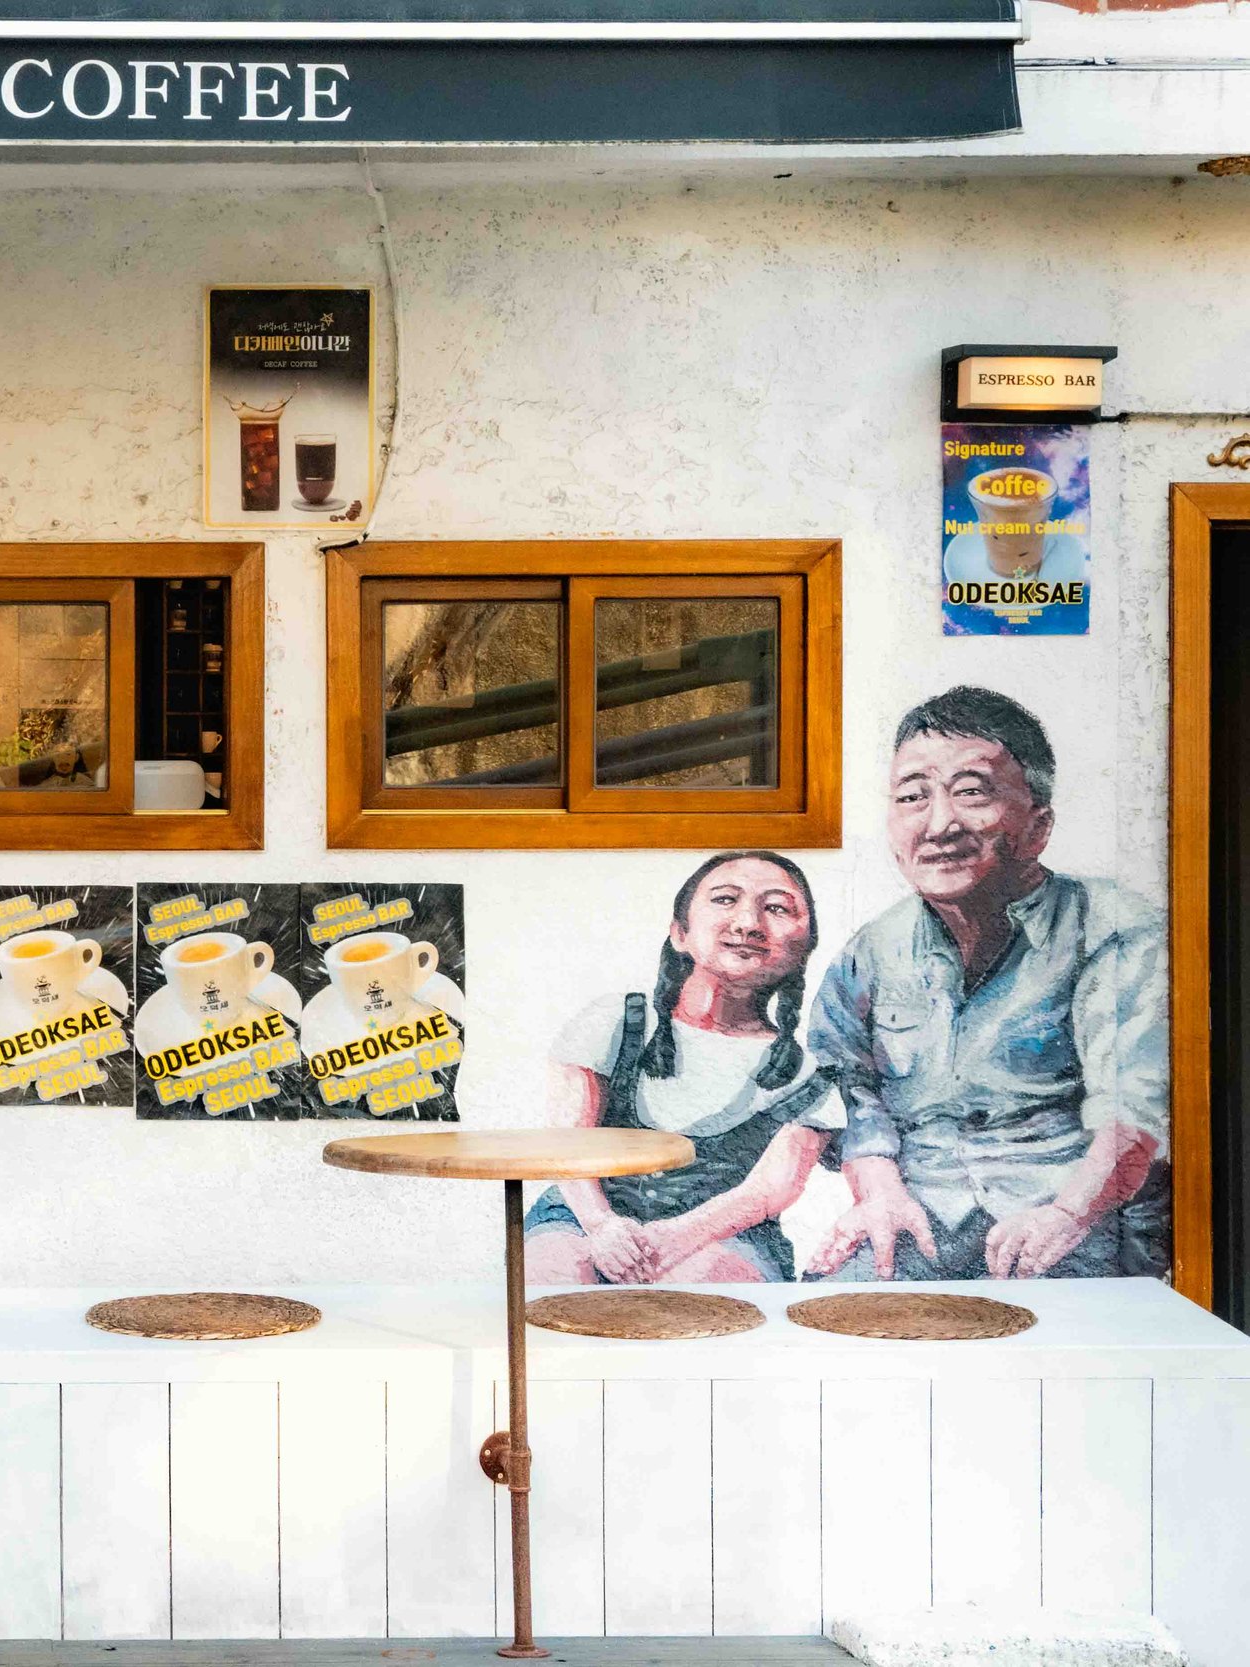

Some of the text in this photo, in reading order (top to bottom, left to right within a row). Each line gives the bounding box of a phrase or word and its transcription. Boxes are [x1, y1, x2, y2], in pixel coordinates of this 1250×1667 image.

[0, 58, 352, 122] COFFEE
[978, 373, 1096, 387] ESPRESSO BAR
[944, 440, 1025, 460] Signature
[975, 475, 1050, 497] Coffee
[944, 519, 1086, 536] Nut cream coffee
[948, 581, 1084, 606] ODEOKSAE
[45, 902, 75, 921] BAR
[147, 902, 245, 941] Espresso BAR
[152, 897, 202, 922] SEOUL
[311, 901, 409, 941] Espresso BAR
[316, 897, 366, 922] SEOUL
[83, 1030, 126, 1060] BAR
[146, 1013, 285, 1077] ODEOKSAE
[310, 1013, 450, 1077] ODEOKSAE
[39, 1063, 105, 1100] SEOUL
[158, 1041, 299, 1102] Espresso BAR
[322, 1041, 462, 1102] Espresso BAR
[206, 1075, 277, 1113] SEOUL
[370, 1075, 442, 1113] SEOUL
